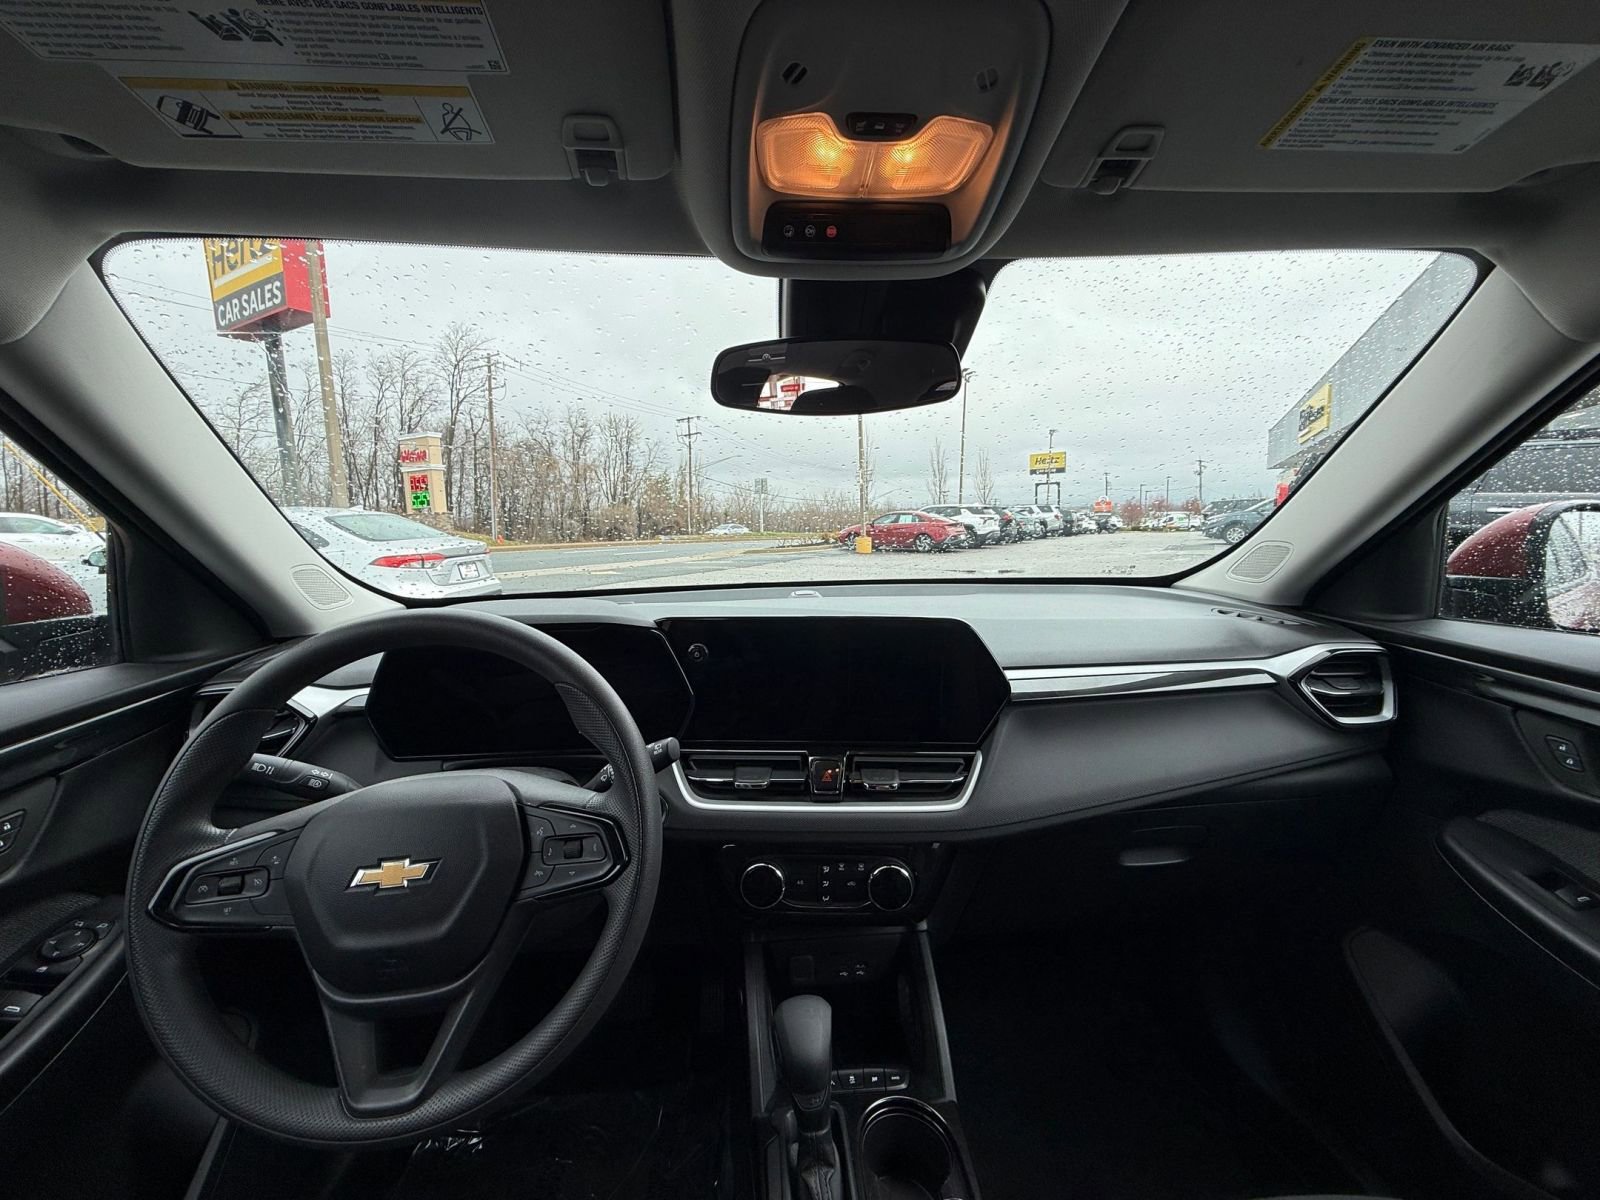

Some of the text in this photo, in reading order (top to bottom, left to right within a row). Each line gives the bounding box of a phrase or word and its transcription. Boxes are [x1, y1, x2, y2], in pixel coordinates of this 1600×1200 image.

[335, 1, 361, 10] SACS
[361, 2, 421, 13] GONFLABLES
[421, 4, 484, 15] INTELLIGENTS
[1372, 40, 1396, 48] EVEN
[1396, 40, 1420, 48] WITH
[1420, 41, 1472, 50] ADVANCED
[217, 280, 282, 327] CAR SALES
[1034, 455, 1060, 466] Hertz
